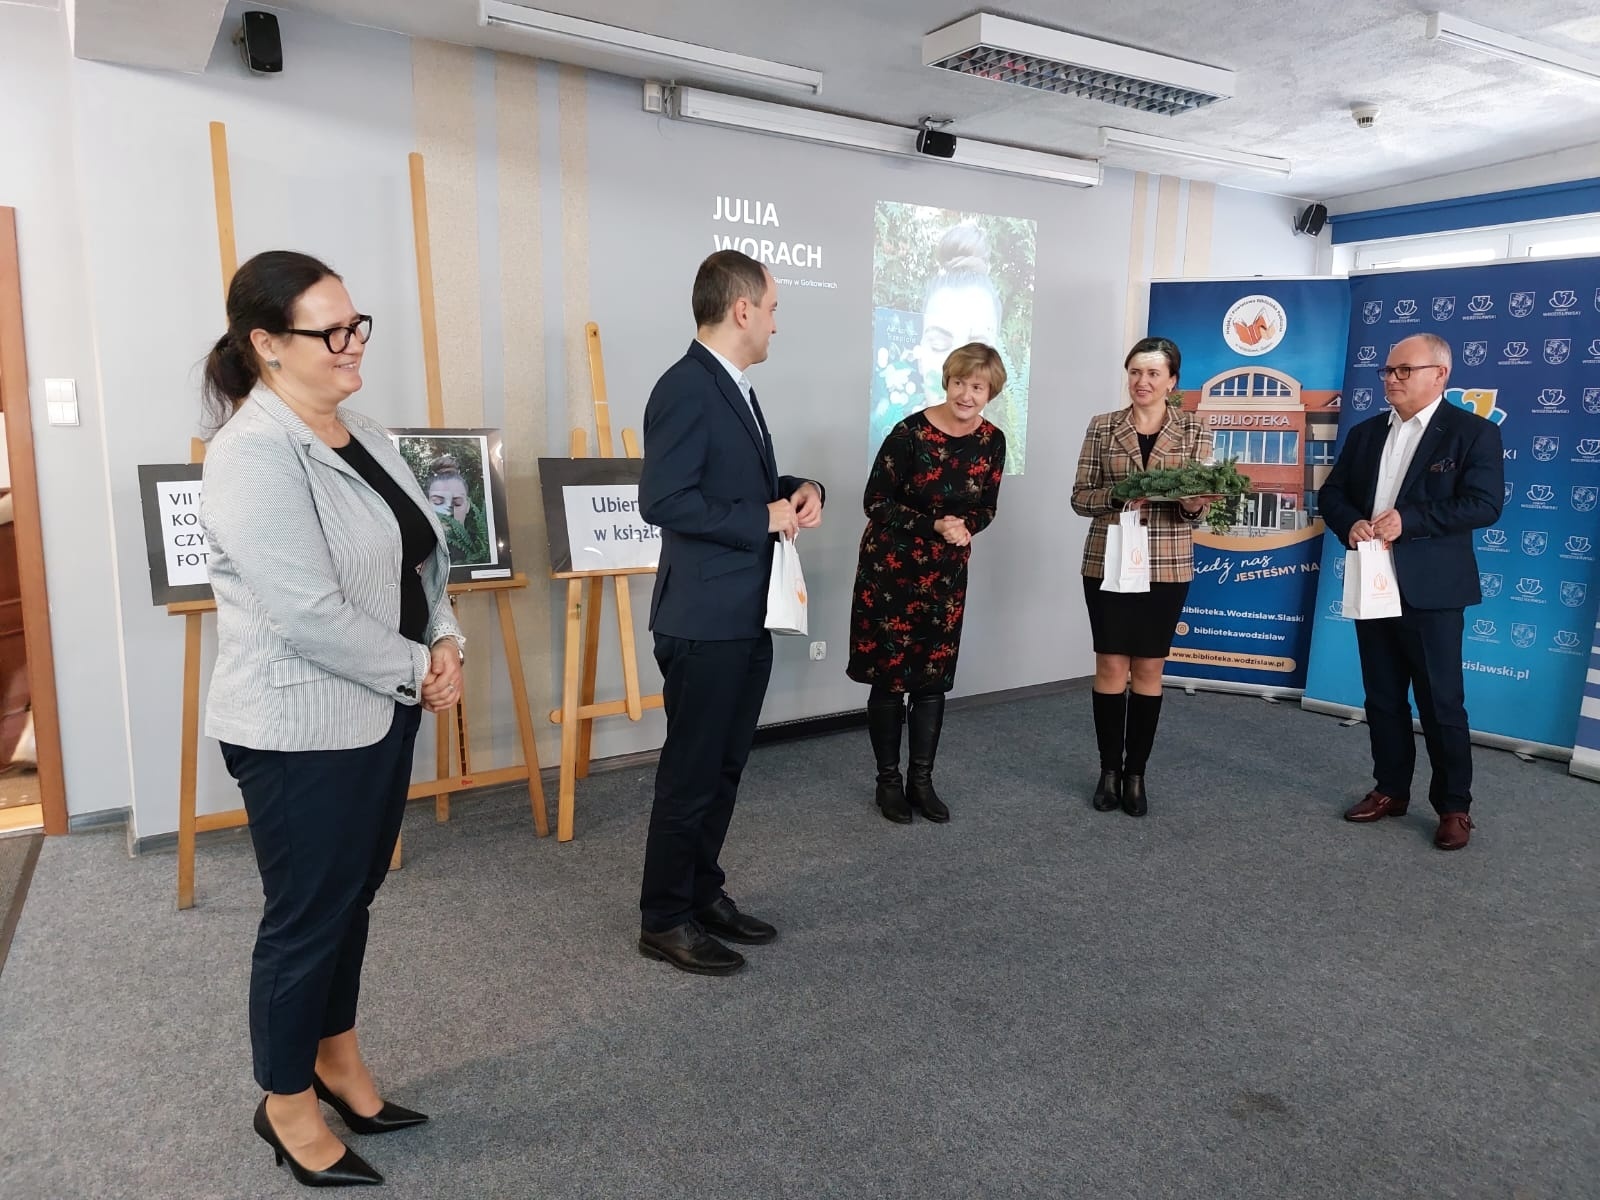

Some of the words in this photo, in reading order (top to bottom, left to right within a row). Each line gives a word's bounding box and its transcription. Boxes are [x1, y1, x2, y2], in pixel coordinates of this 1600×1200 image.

[713, 196, 779, 227] JULIA
[713, 234, 822, 269] WORACH
[1209, 414, 1290, 426] BIBLIOTEKA
[169, 492, 192, 505] VII
[592, 496, 638, 513] Ubier
[172, 513, 197, 526] KO
[174, 533, 205, 547] CZY
[594, 529, 607, 541] w
[177, 553, 210, 567] FOT
[1193, 557, 1235, 585] iedź
[1241, 555, 1272, 568] nas
[1234, 564, 1297, 582] JESTEŚMY
[1301, 562, 1320, 573] NA
[1194, 626, 1285, 641] bibliotekawodzislaw
[1172, 650, 1285, 668] www.biblioteka.wodzislaw.pl
